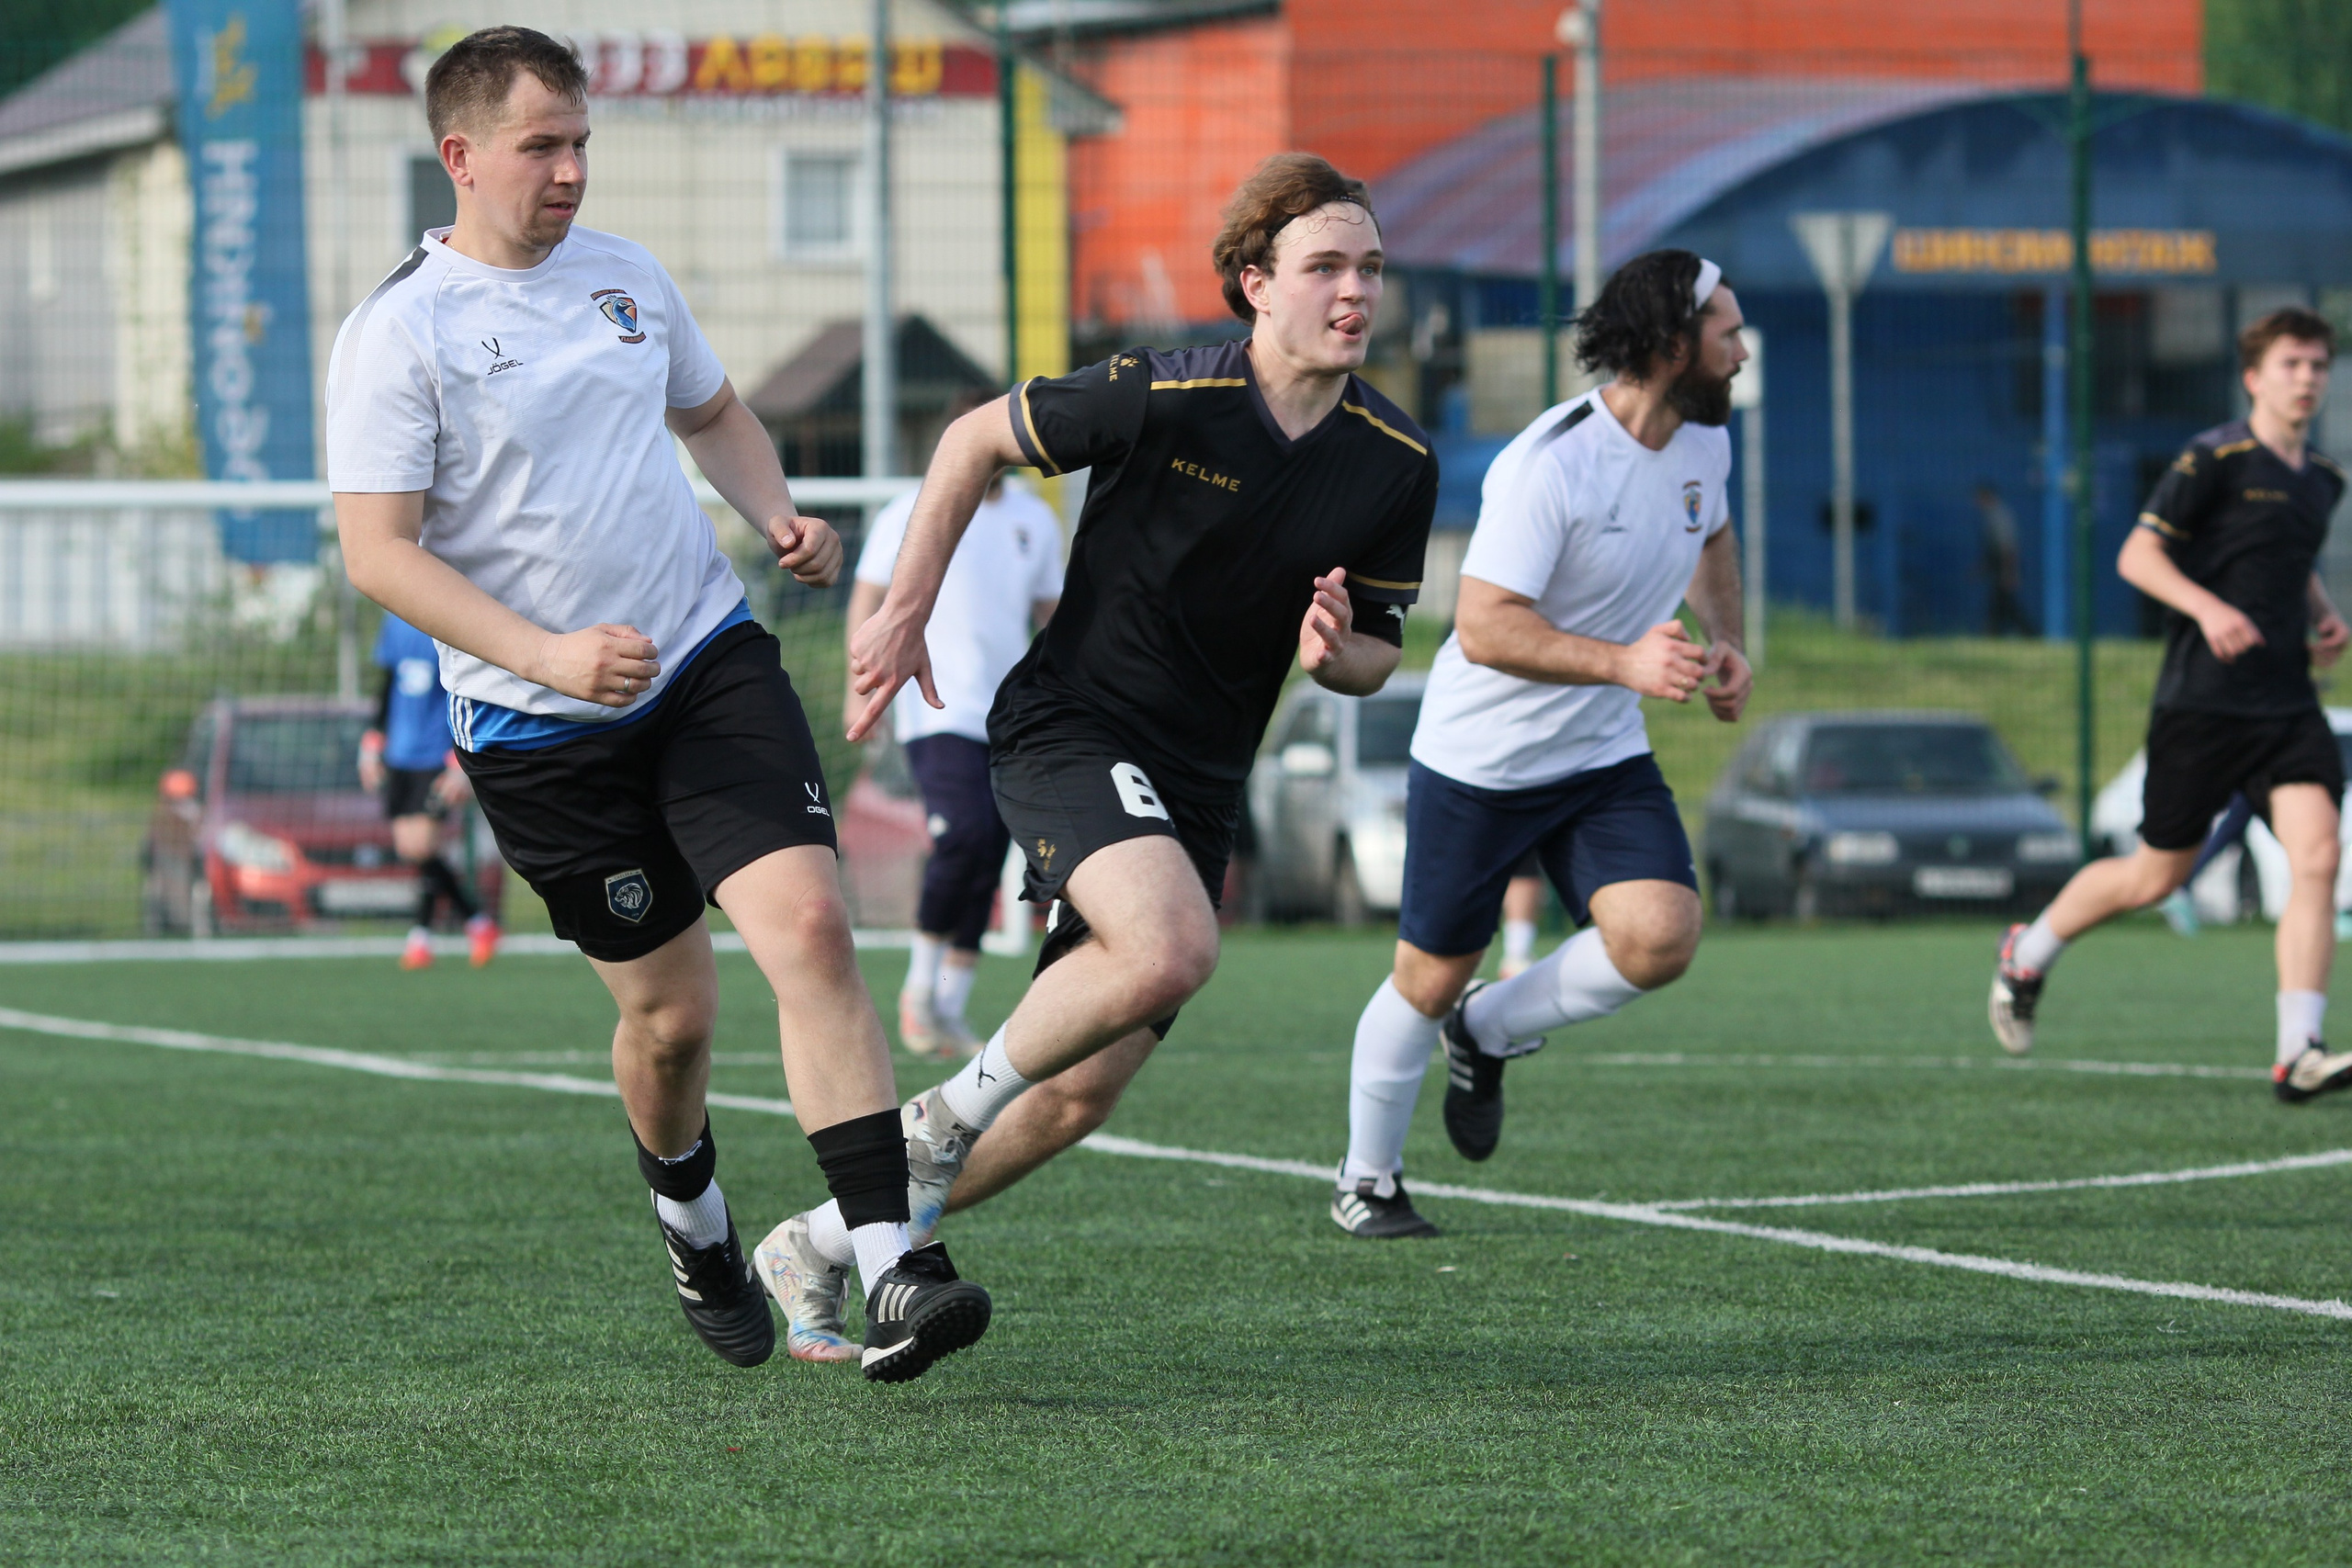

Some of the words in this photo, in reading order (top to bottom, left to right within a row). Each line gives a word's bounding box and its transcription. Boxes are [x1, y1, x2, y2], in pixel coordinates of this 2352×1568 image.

[487, 359, 524, 376] JÖGEL
[1171, 457, 1241, 492] KELME
[1110, 761, 1170, 821] 6
[614, 872, 633, 880] CHELSEA
